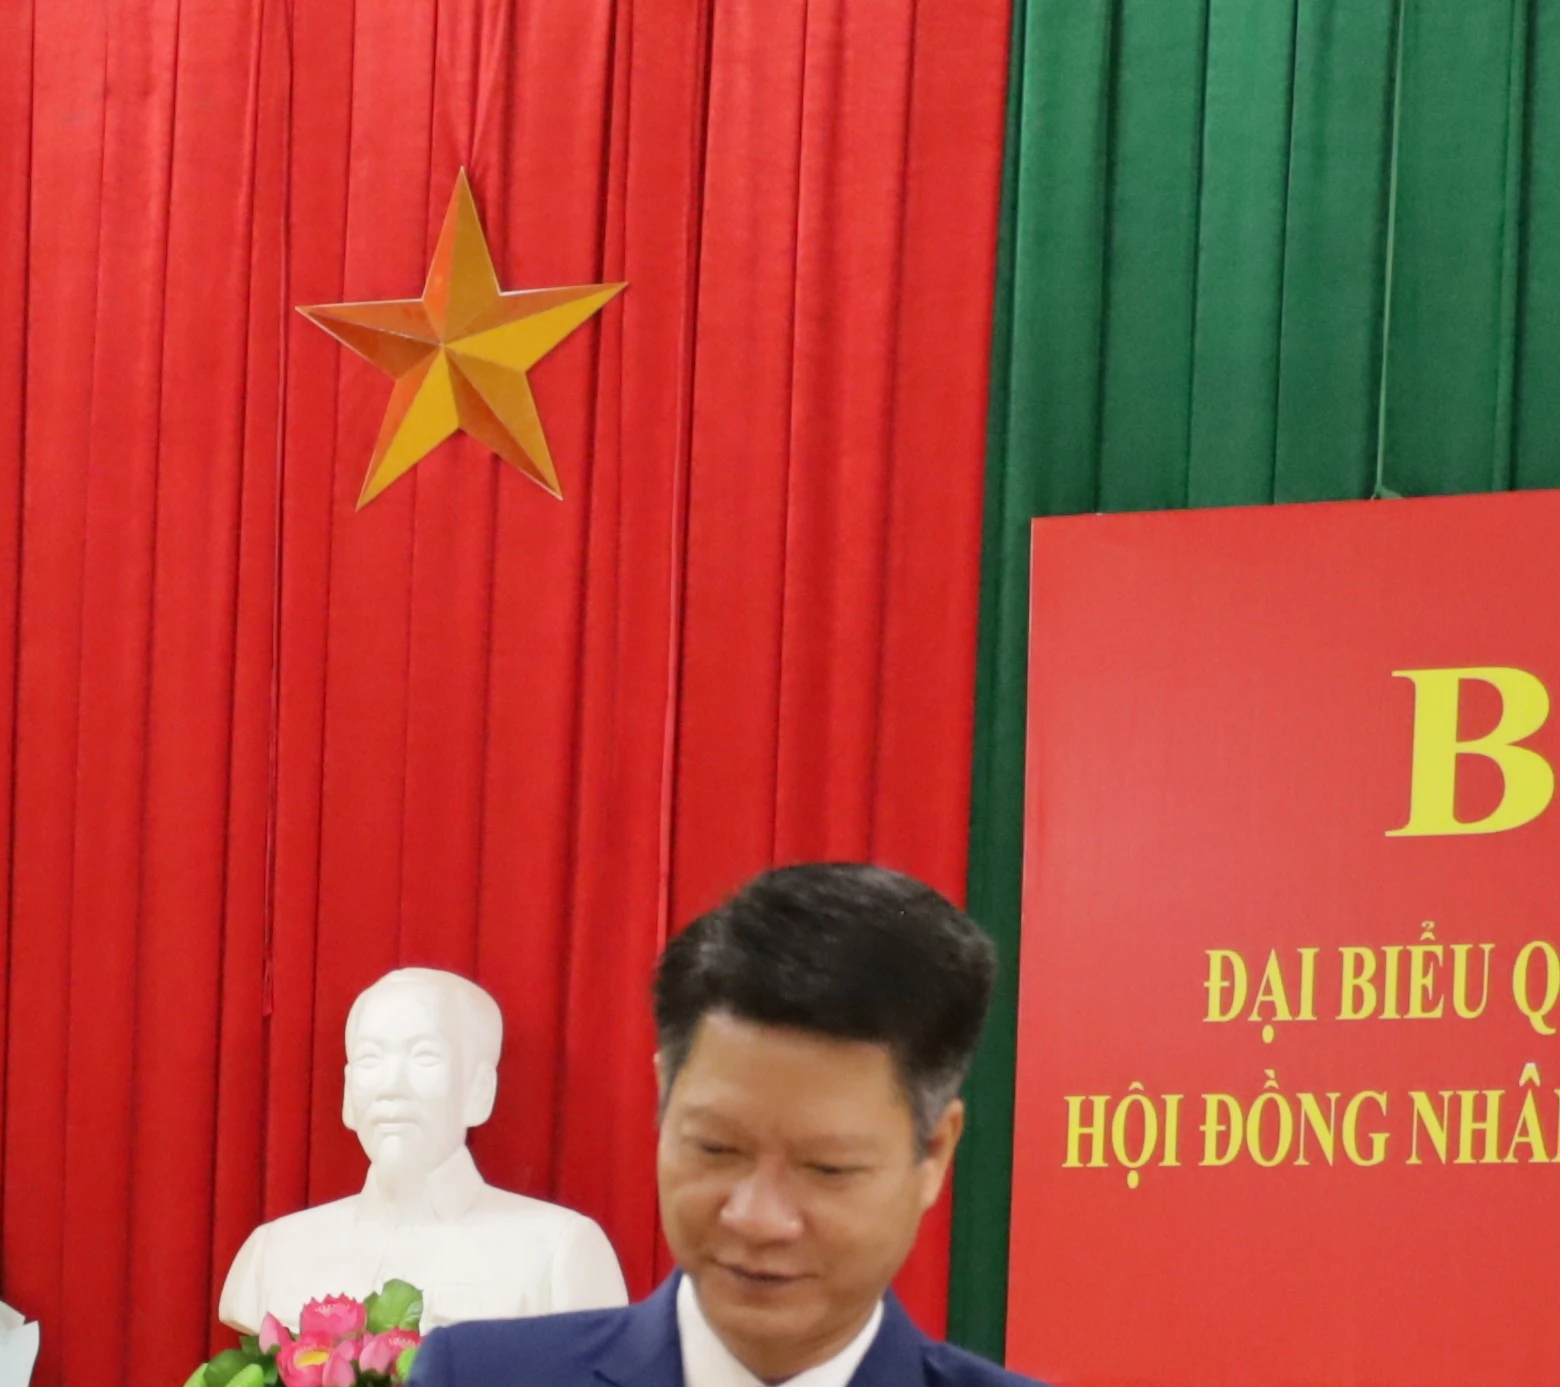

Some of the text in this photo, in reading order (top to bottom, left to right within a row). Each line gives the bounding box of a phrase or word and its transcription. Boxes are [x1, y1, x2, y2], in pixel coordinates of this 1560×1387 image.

[1201, 945, 1321, 1045] ĐẠI
[1334, 919, 1496, 1023] BIỂU
[1061, 1079, 1185, 1190] HỘI
[1197, 1067, 1392, 1168] ĐỒNG
